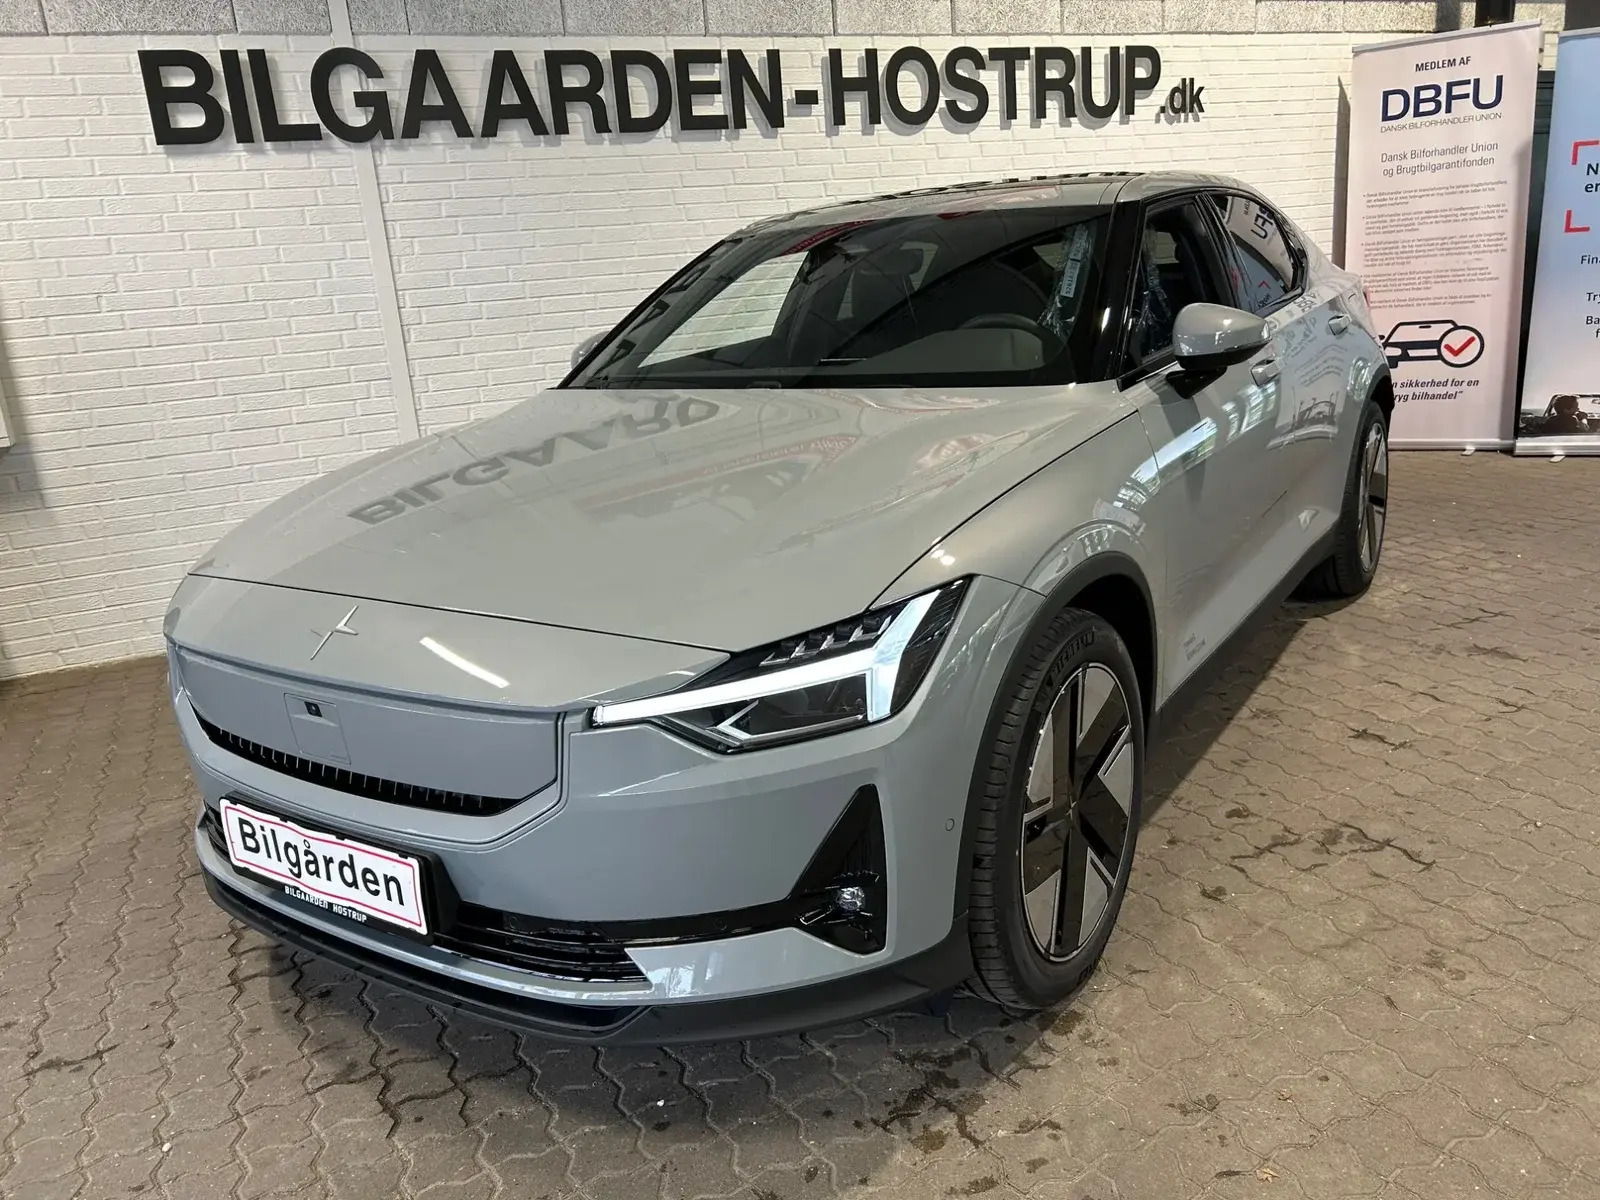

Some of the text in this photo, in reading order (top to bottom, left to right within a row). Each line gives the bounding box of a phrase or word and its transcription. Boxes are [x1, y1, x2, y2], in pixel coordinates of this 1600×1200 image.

[1415, 56, 1472, 72] MEDLEM AF
[1381, 75, 1504, 122] DBFU
[1380, 112, 1502, 133] DANSK BILFORHANDLER UNION
[1381, 141, 1499, 163] Dansk Bilforhandler Union
[1382, 155, 1495, 178] og Brugtbilgarantifonden
[1581, 254, 1600, 265] Fin
[1400, 378, 1450, 389] sikkerhed
[1450, 377, 1465, 387] for
[1466, 379, 1480, 387] en
[1394, 393, 1409, 403] ryg
[237, 816, 406, 907] Bilgården
[284, 885, 367, 923] BILGAARDEN HOSTRUP
